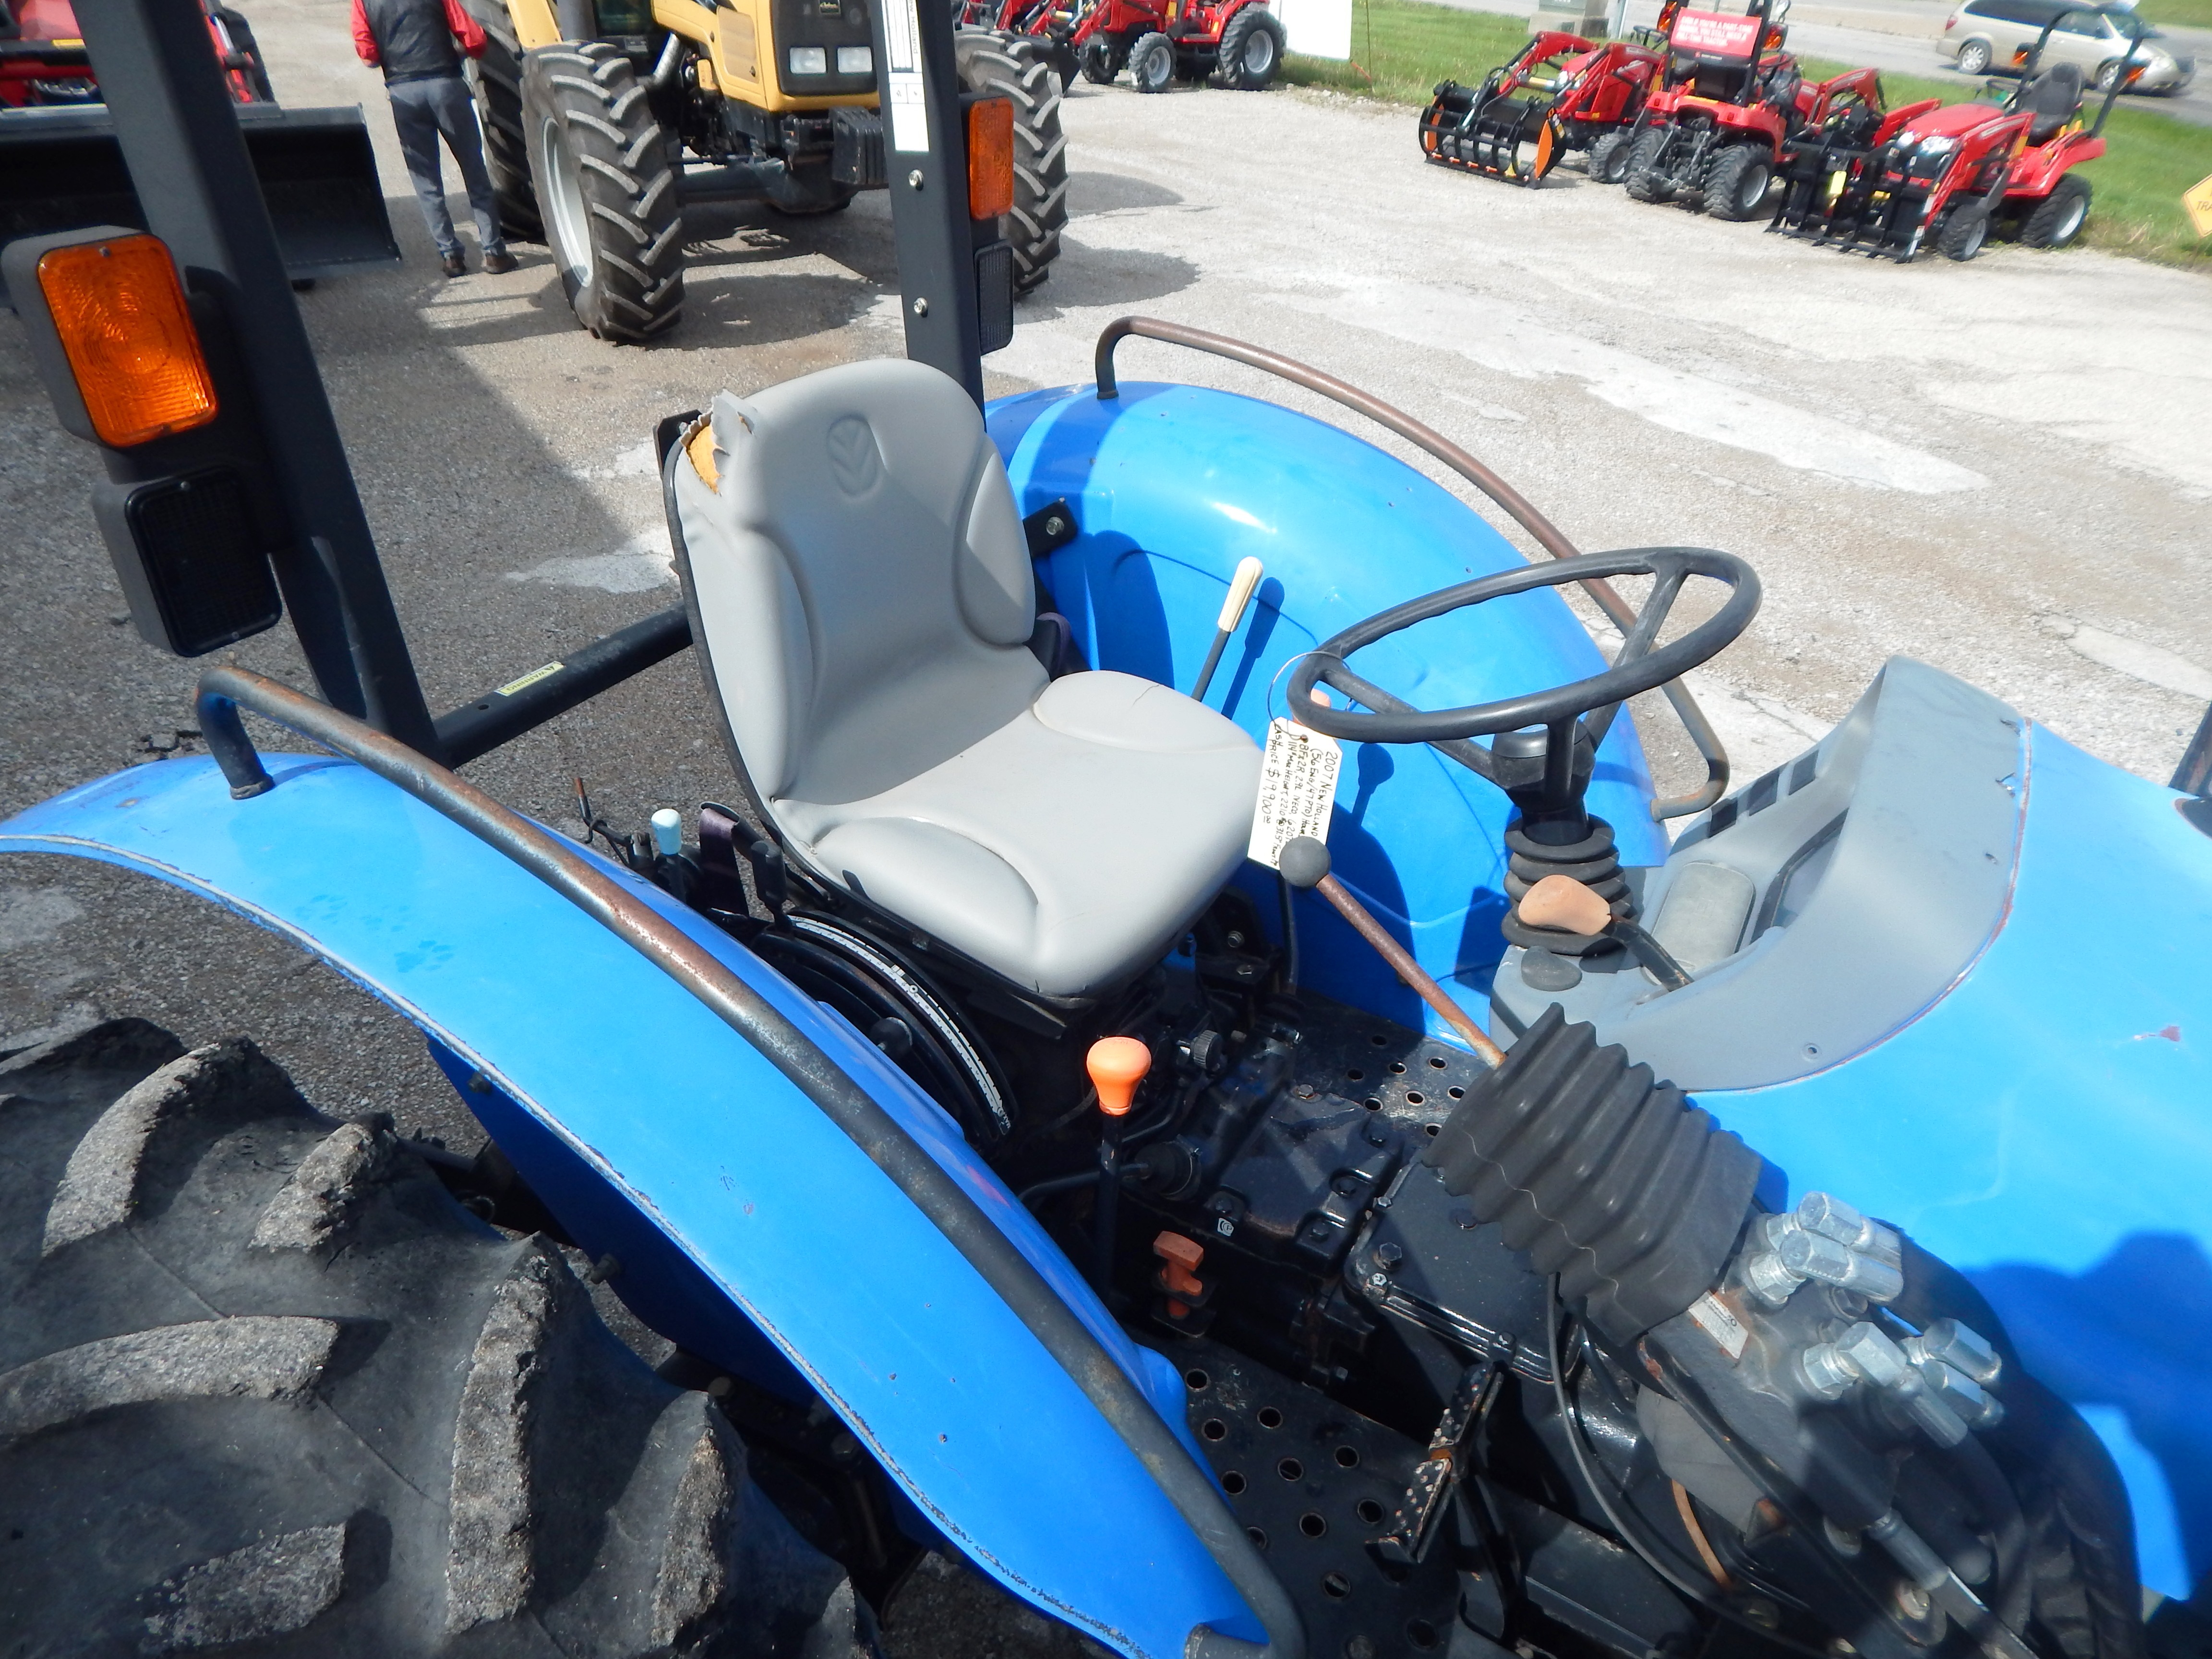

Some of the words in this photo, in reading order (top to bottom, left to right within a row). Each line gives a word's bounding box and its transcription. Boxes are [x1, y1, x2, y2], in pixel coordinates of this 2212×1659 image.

[1711, 29, 1725, 38] STILL
[506, 671, 548, 691] WARNING
[1269, 739, 1279, 765] PRICE
[1310, 748, 1324, 766] (56
[1322, 751, 1338, 780] 2007
[1317, 781, 1333, 803] NEW
[1301, 799, 1313, 817] PTO)
[1311, 803, 1328, 837] HOLLAND
